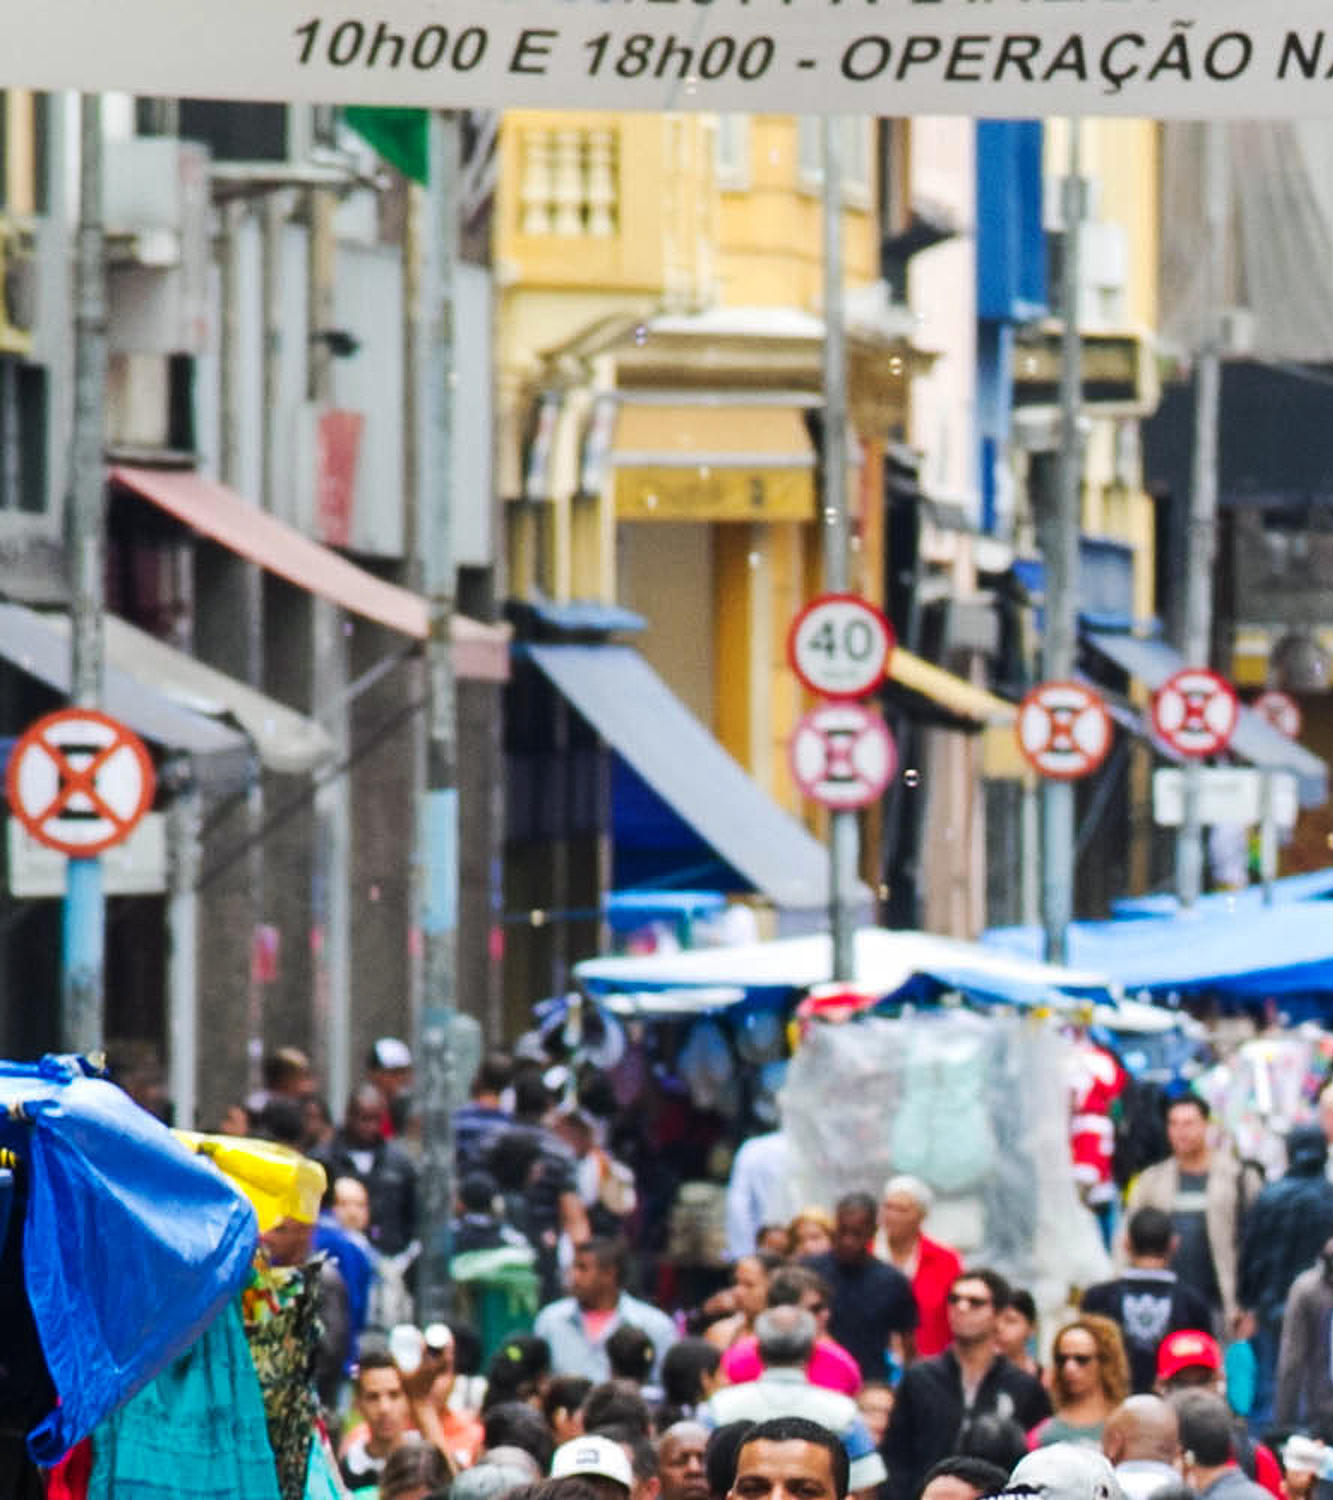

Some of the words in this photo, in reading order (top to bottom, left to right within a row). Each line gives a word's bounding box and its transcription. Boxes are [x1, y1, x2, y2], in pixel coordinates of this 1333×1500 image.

[293, 18, 490, 72] 10h00
[508, 29, 560, 75] E
[583, 33, 777, 82] 18h00
[840, 20, 1253, 95] OPERAÇÃO
[808, 618, 874, 663] 40
